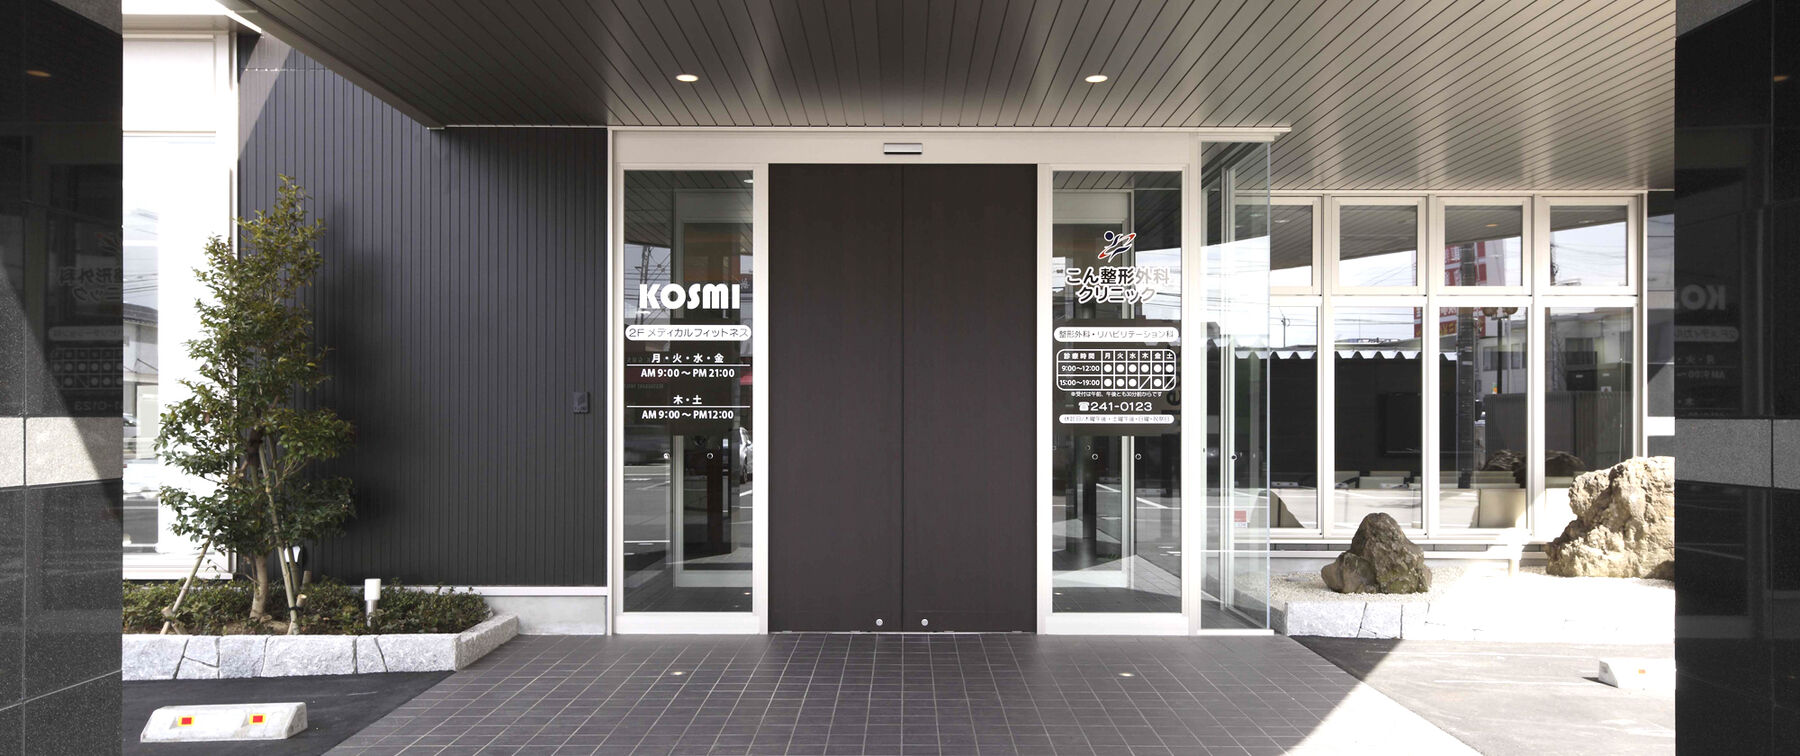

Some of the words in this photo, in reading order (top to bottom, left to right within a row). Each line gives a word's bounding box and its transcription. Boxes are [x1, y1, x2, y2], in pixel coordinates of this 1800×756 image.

[1066, 266, 1170, 285] こん整形外科
[639, 283, 741, 310] KOSMI
[1078, 285, 1156, 303] クリニック
[629, 328, 645, 338] 2F
[647, 328, 749, 338] メディカルフィットネス
[1059, 330, 1174, 339] 整形外科・リハビリテーション科
[1104, 352, 1111, 360] 月
[1117, 352, 1124, 360] 火
[1129, 352, 1137, 360] 水
[1141, 352, 1149, 360] 木
[1154, 352, 1162, 360] 金
[1166, 352, 1174, 360] 土
[640, 368, 656, 378] AM
[657, 368, 680, 378] 9:00
[692, 368, 707, 378] PM
[708, 368, 735, 378] 21:00
[1090, 401, 1153, 411] 241-0123
[641, 410, 657, 420] AM
[658, 410, 680, 420] 9:00
